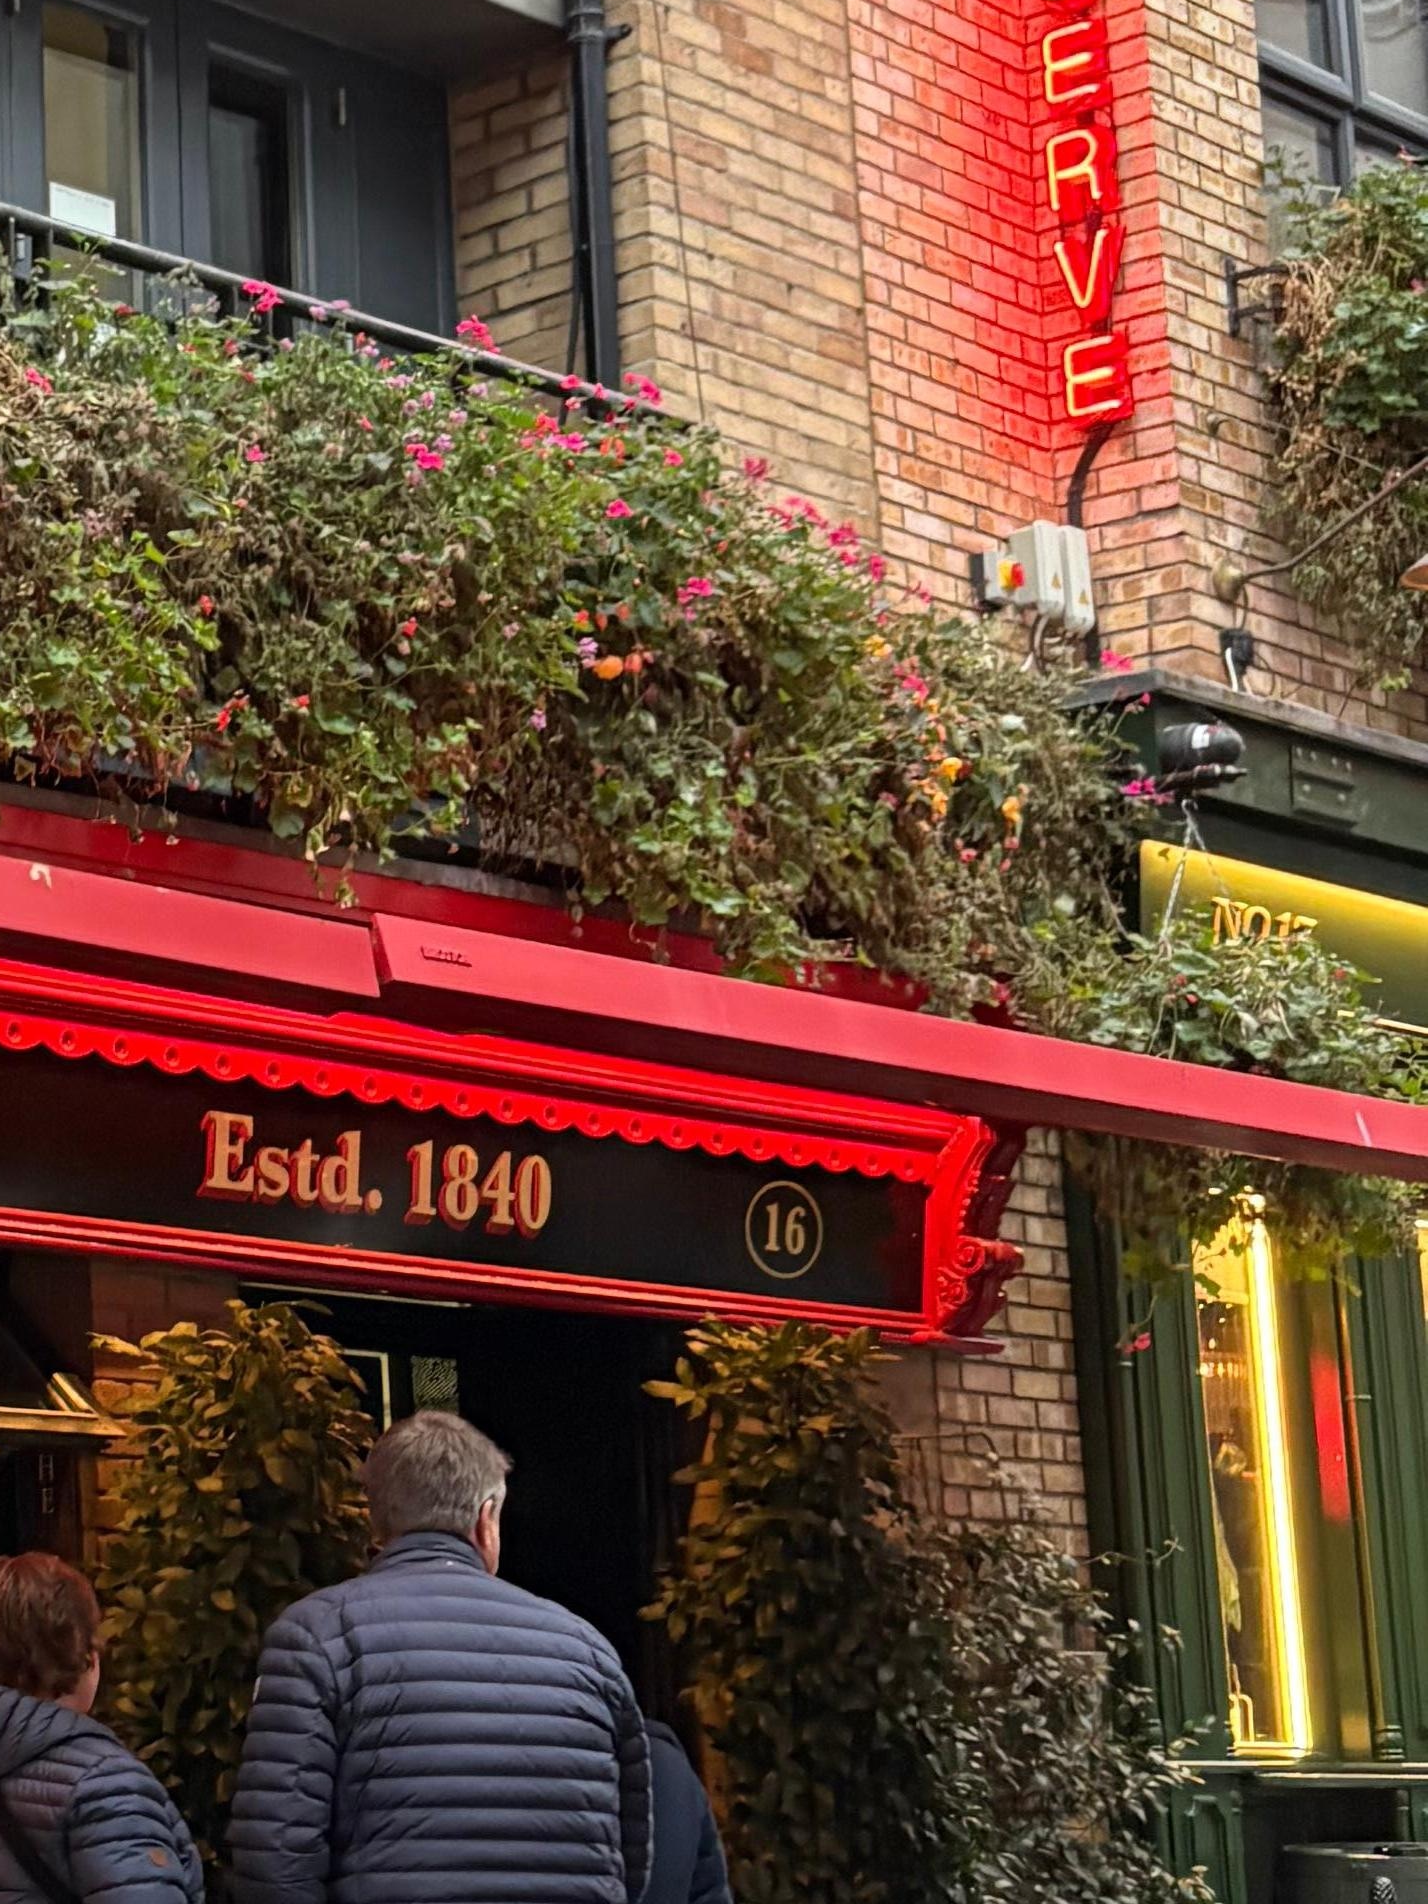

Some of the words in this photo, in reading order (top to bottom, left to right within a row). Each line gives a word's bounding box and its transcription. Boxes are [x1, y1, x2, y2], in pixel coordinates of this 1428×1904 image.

[198, 1107, 385, 1216] Estd.
[403, 1138, 556, 1239] 1840
[761, 1197, 808, 1253] 16
